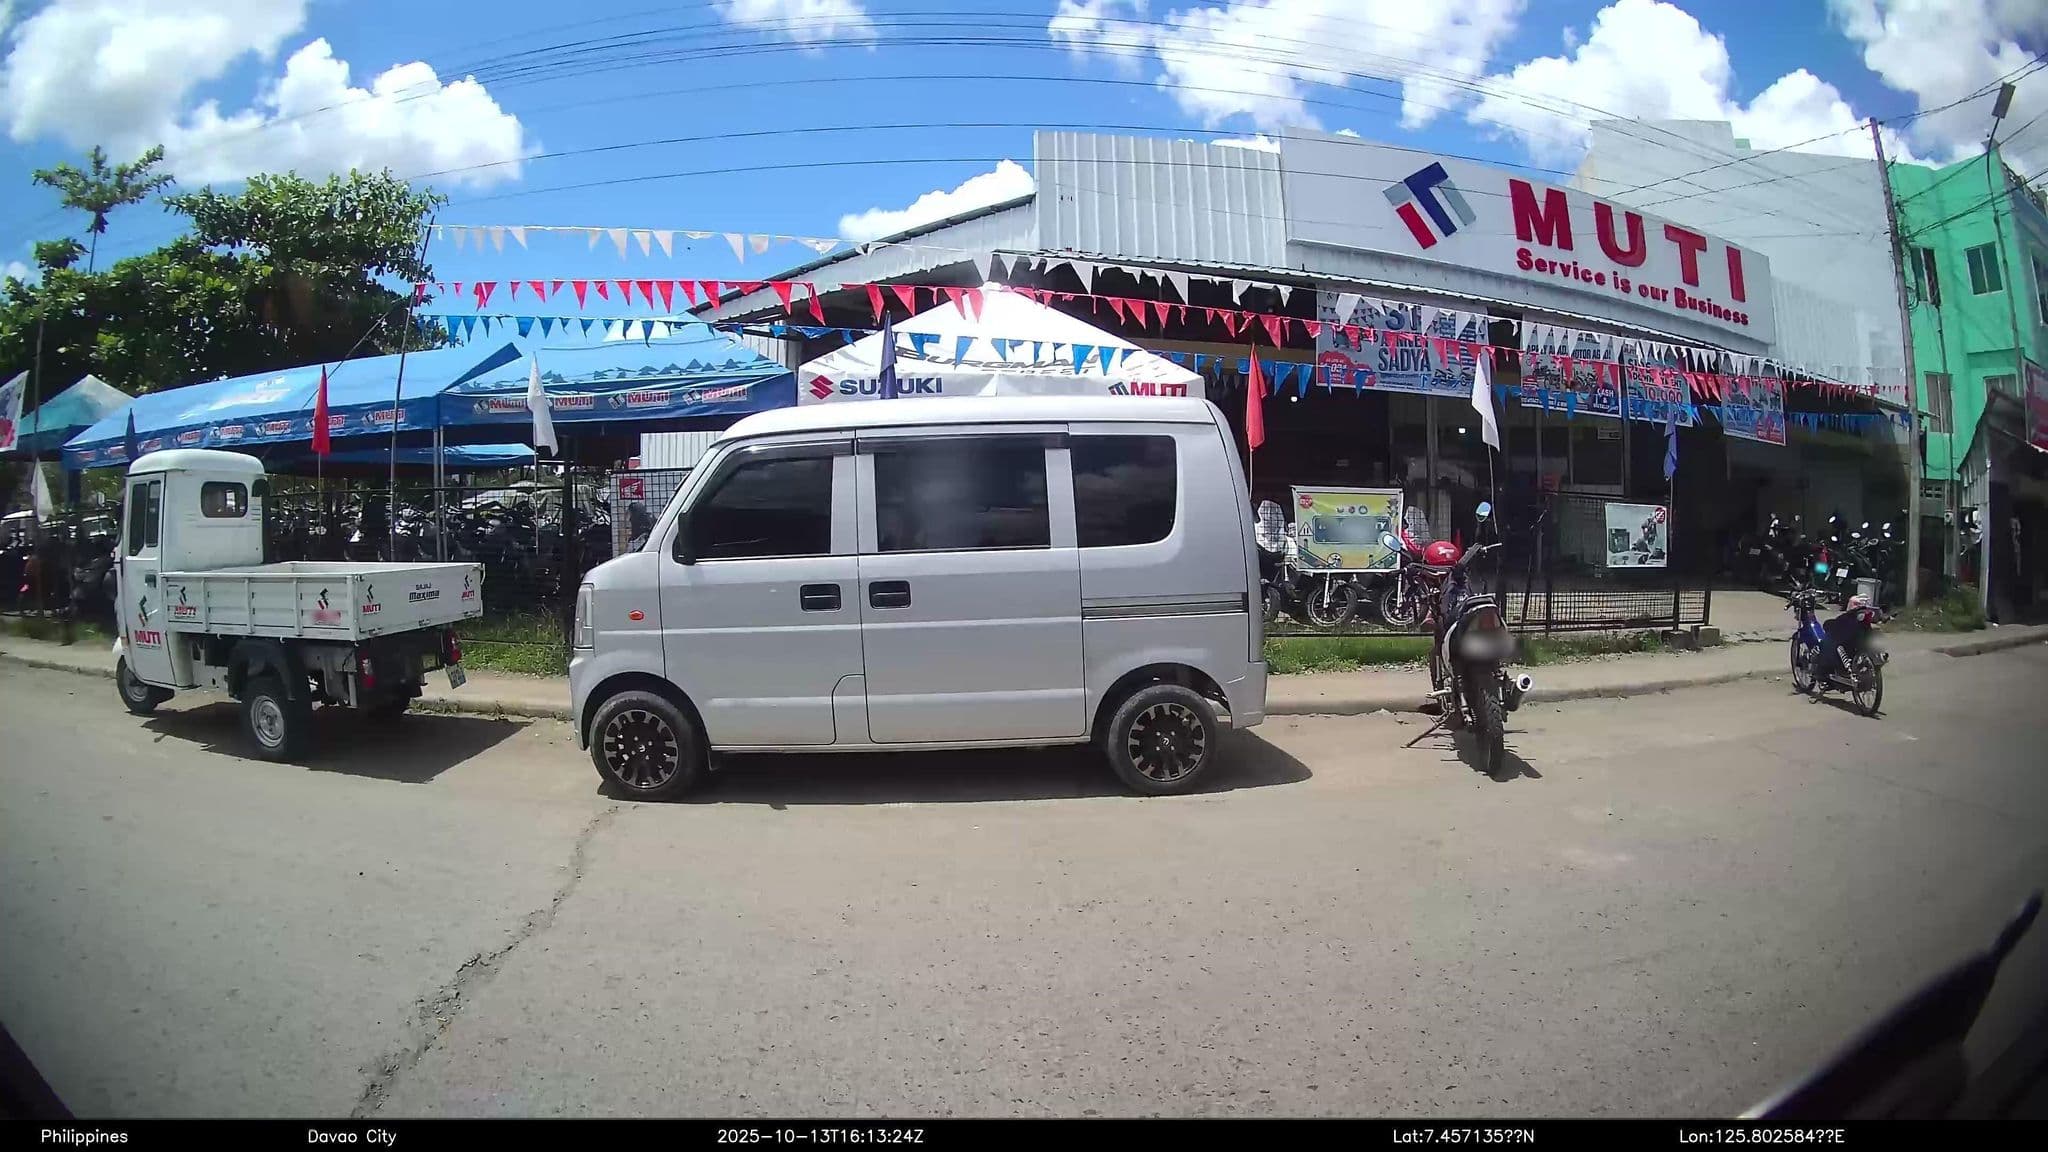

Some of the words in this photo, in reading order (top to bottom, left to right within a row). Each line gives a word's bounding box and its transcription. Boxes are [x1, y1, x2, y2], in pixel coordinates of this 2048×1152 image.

[1509, 178, 1745, 303] MUTI
[1516, 247, 1606, 286] Service
[1613, 271, 1631, 294] is
[1638, 283, 1669, 302] our
[1674, 287, 1748, 326] Business
[1378, 347, 1431, 371] SADYA
[840, 378, 942, 395] SUUKI
[409, 590, 440, 600] Maxima
[175, 606, 196, 615] MUTI
[363, 604, 381, 613] MUTI
[135, 631, 160, 644] MUTI
